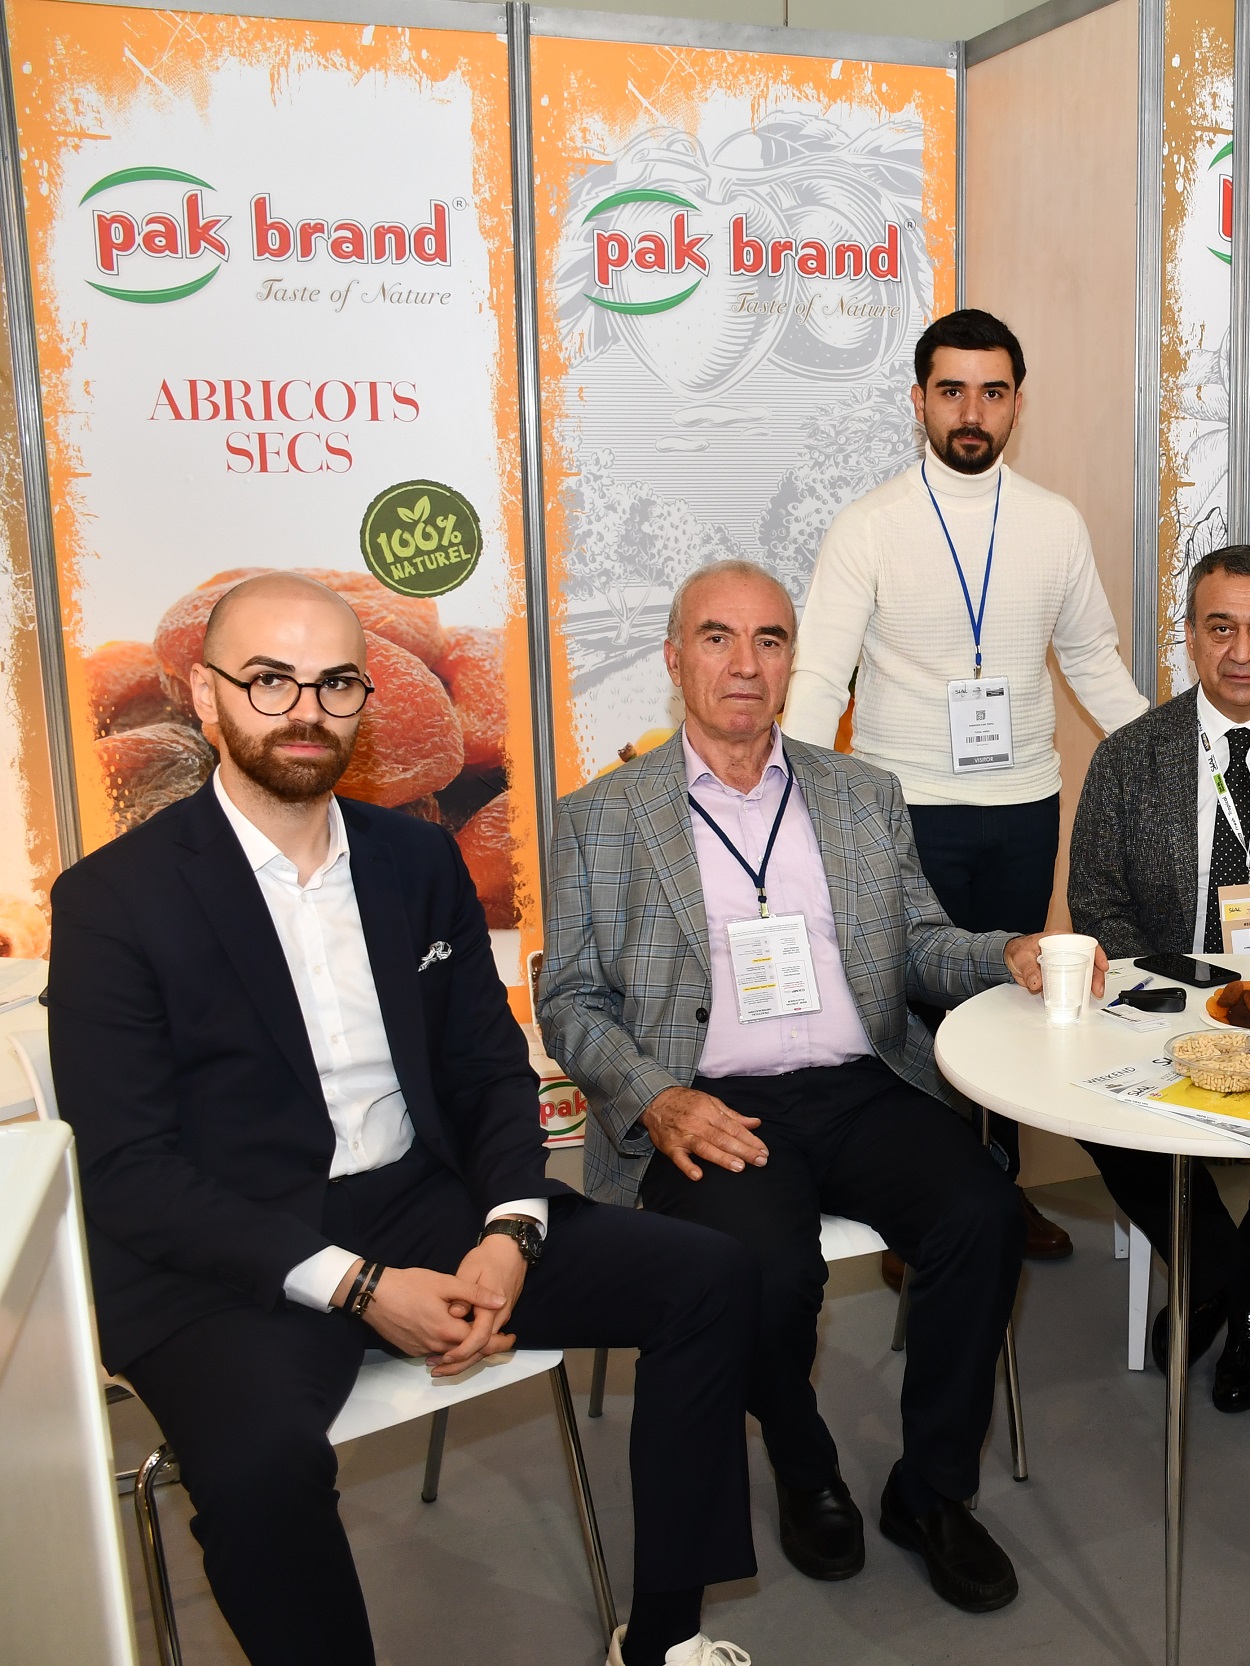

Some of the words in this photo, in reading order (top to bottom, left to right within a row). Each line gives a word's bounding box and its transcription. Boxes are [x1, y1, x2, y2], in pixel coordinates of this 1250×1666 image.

[92, 189, 231, 275] pak
[251, 193, 451, 266] brand
[593, 210, 713, 289] pak
[729, 213, 901, 283] brand
[256, 278, 319, 303] Taste
[330, 280, 359, 313] of
[361, 282, 451, 305] Nature
[731, 292, 787, 315] Taste
[795, 294, 821, 324] of
[822, 295, 901, 319] Nature
[147, 378, 420, 422] ABRICOTS
[226, 431, 353, 473] SECS
[377, 513, 462, 564] 100%
[390, 545, 471, 580] NATUREL
[974, 756, 994, 764] VISITOR
[1082, 1066, 1136, 1084] WEEKEND
